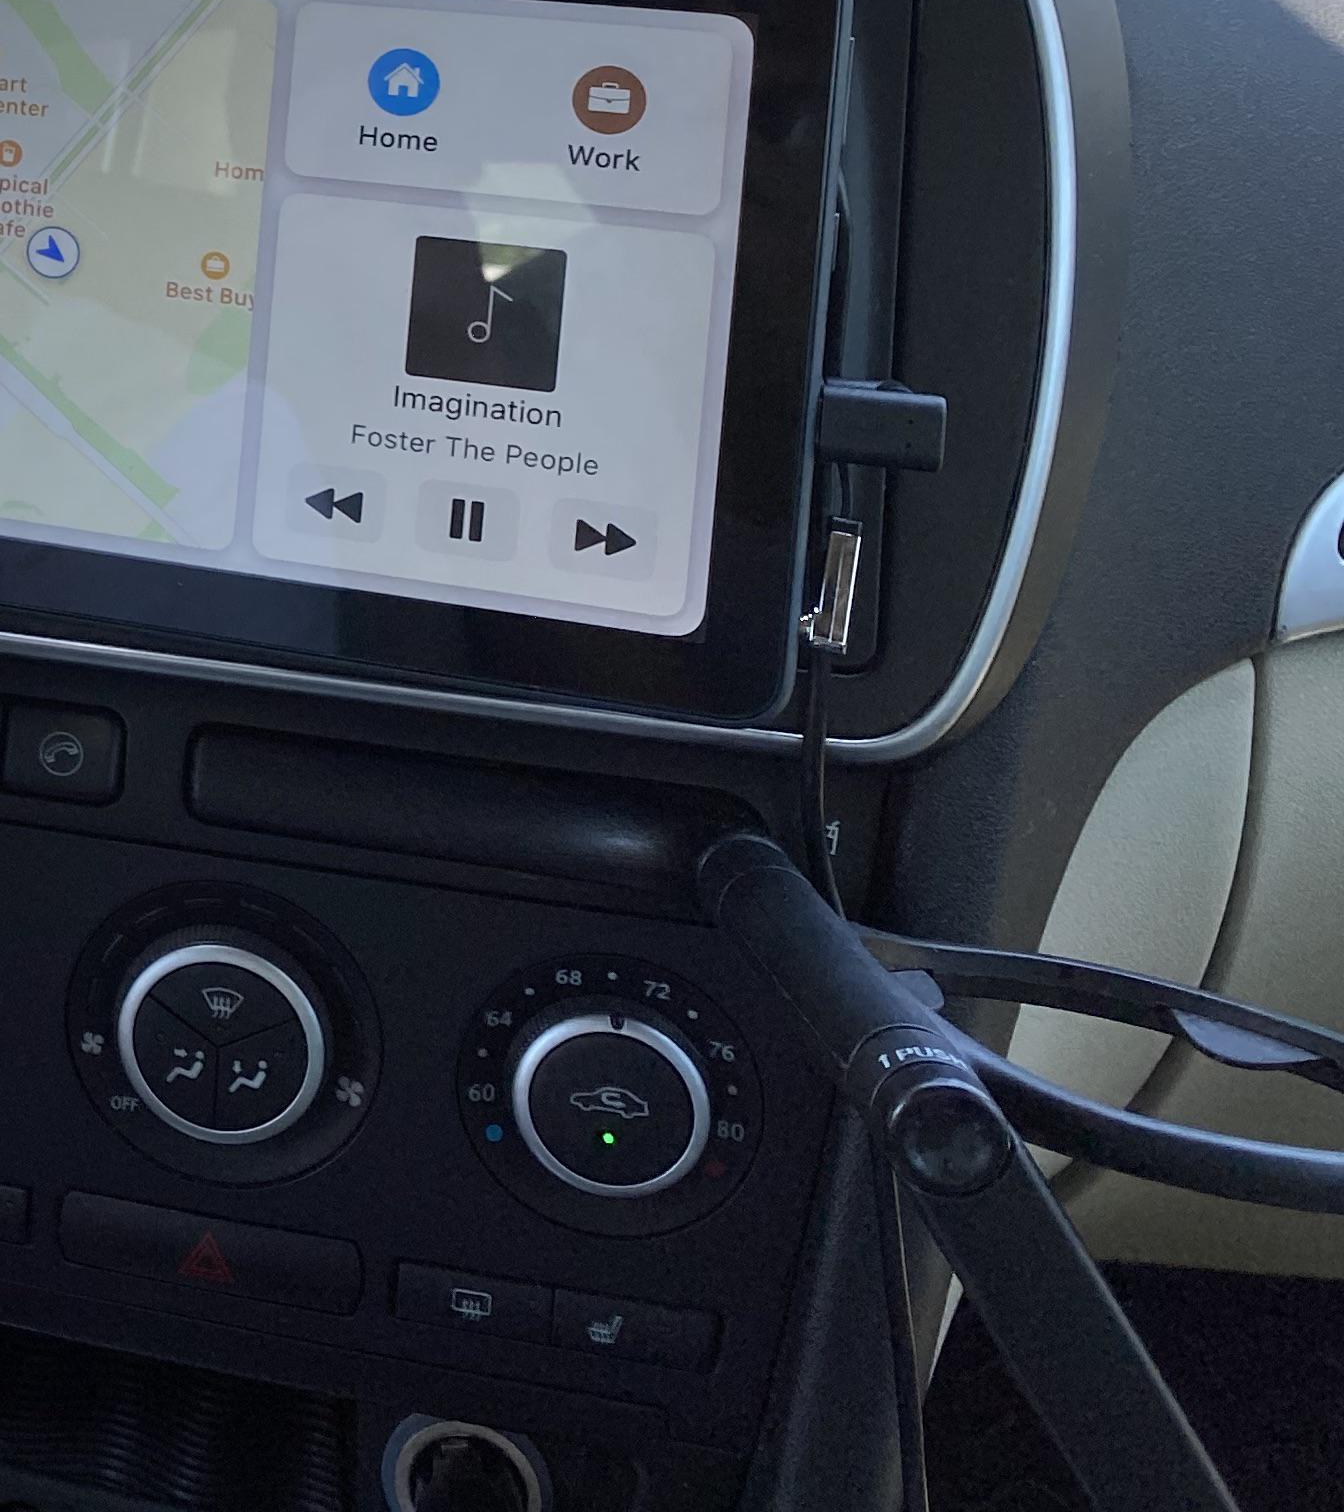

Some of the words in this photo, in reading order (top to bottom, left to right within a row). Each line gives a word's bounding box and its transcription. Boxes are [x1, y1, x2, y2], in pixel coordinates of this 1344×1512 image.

[358, 125, 439, 153] Home
[567, 144, 641, 172] Work
[165, 281, 214, 304] Best
[220, 287, 255, 311] Buy
[393, 385, 562, 428] Imagination
[350, 423, 437, 456] Foster
[446, 435, 496, 464] The
[505, 444, 600, 476] People
[555, 969, 582, 986] 68
[644, 979, 671, 1000] 72
[485, 1010, 513, 1027] 64
[709, 1041, 735, 1063] 76
[111, 1094, 140, 1113] OFF
[468, 1083, 495, 1102] 60
[717, 1120, 745, 1143] 80
